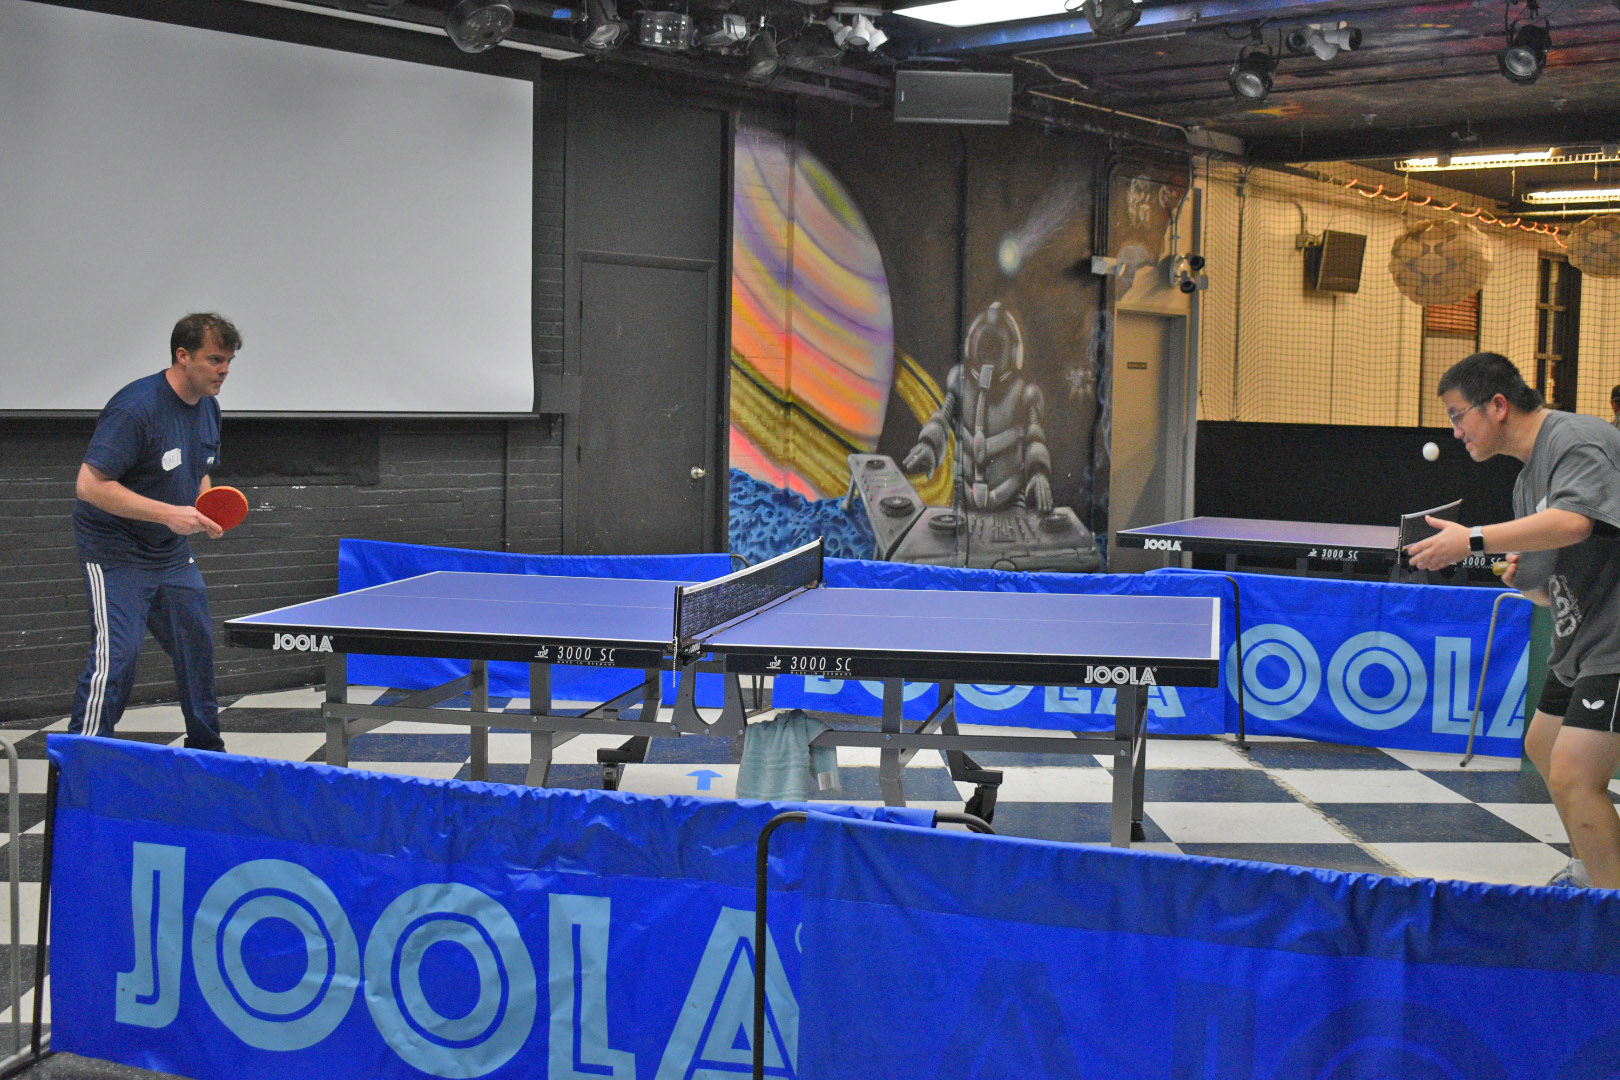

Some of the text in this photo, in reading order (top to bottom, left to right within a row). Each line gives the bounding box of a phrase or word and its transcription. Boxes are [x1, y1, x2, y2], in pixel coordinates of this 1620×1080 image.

[1144, 538, 1182, 551] JOOLA
[1321, 548, 1344, 558] 3000
[1347, 550, 1359, 559] SC
[273, 632, 334, 653] JOOLA
[557, 645, 616, 662] 3000 SC
[790, 656, 852, 671] 3000 SC
[1084, 665, 1157, 686] JOOLA
[115, 841, 800, 1080] JOOLA
